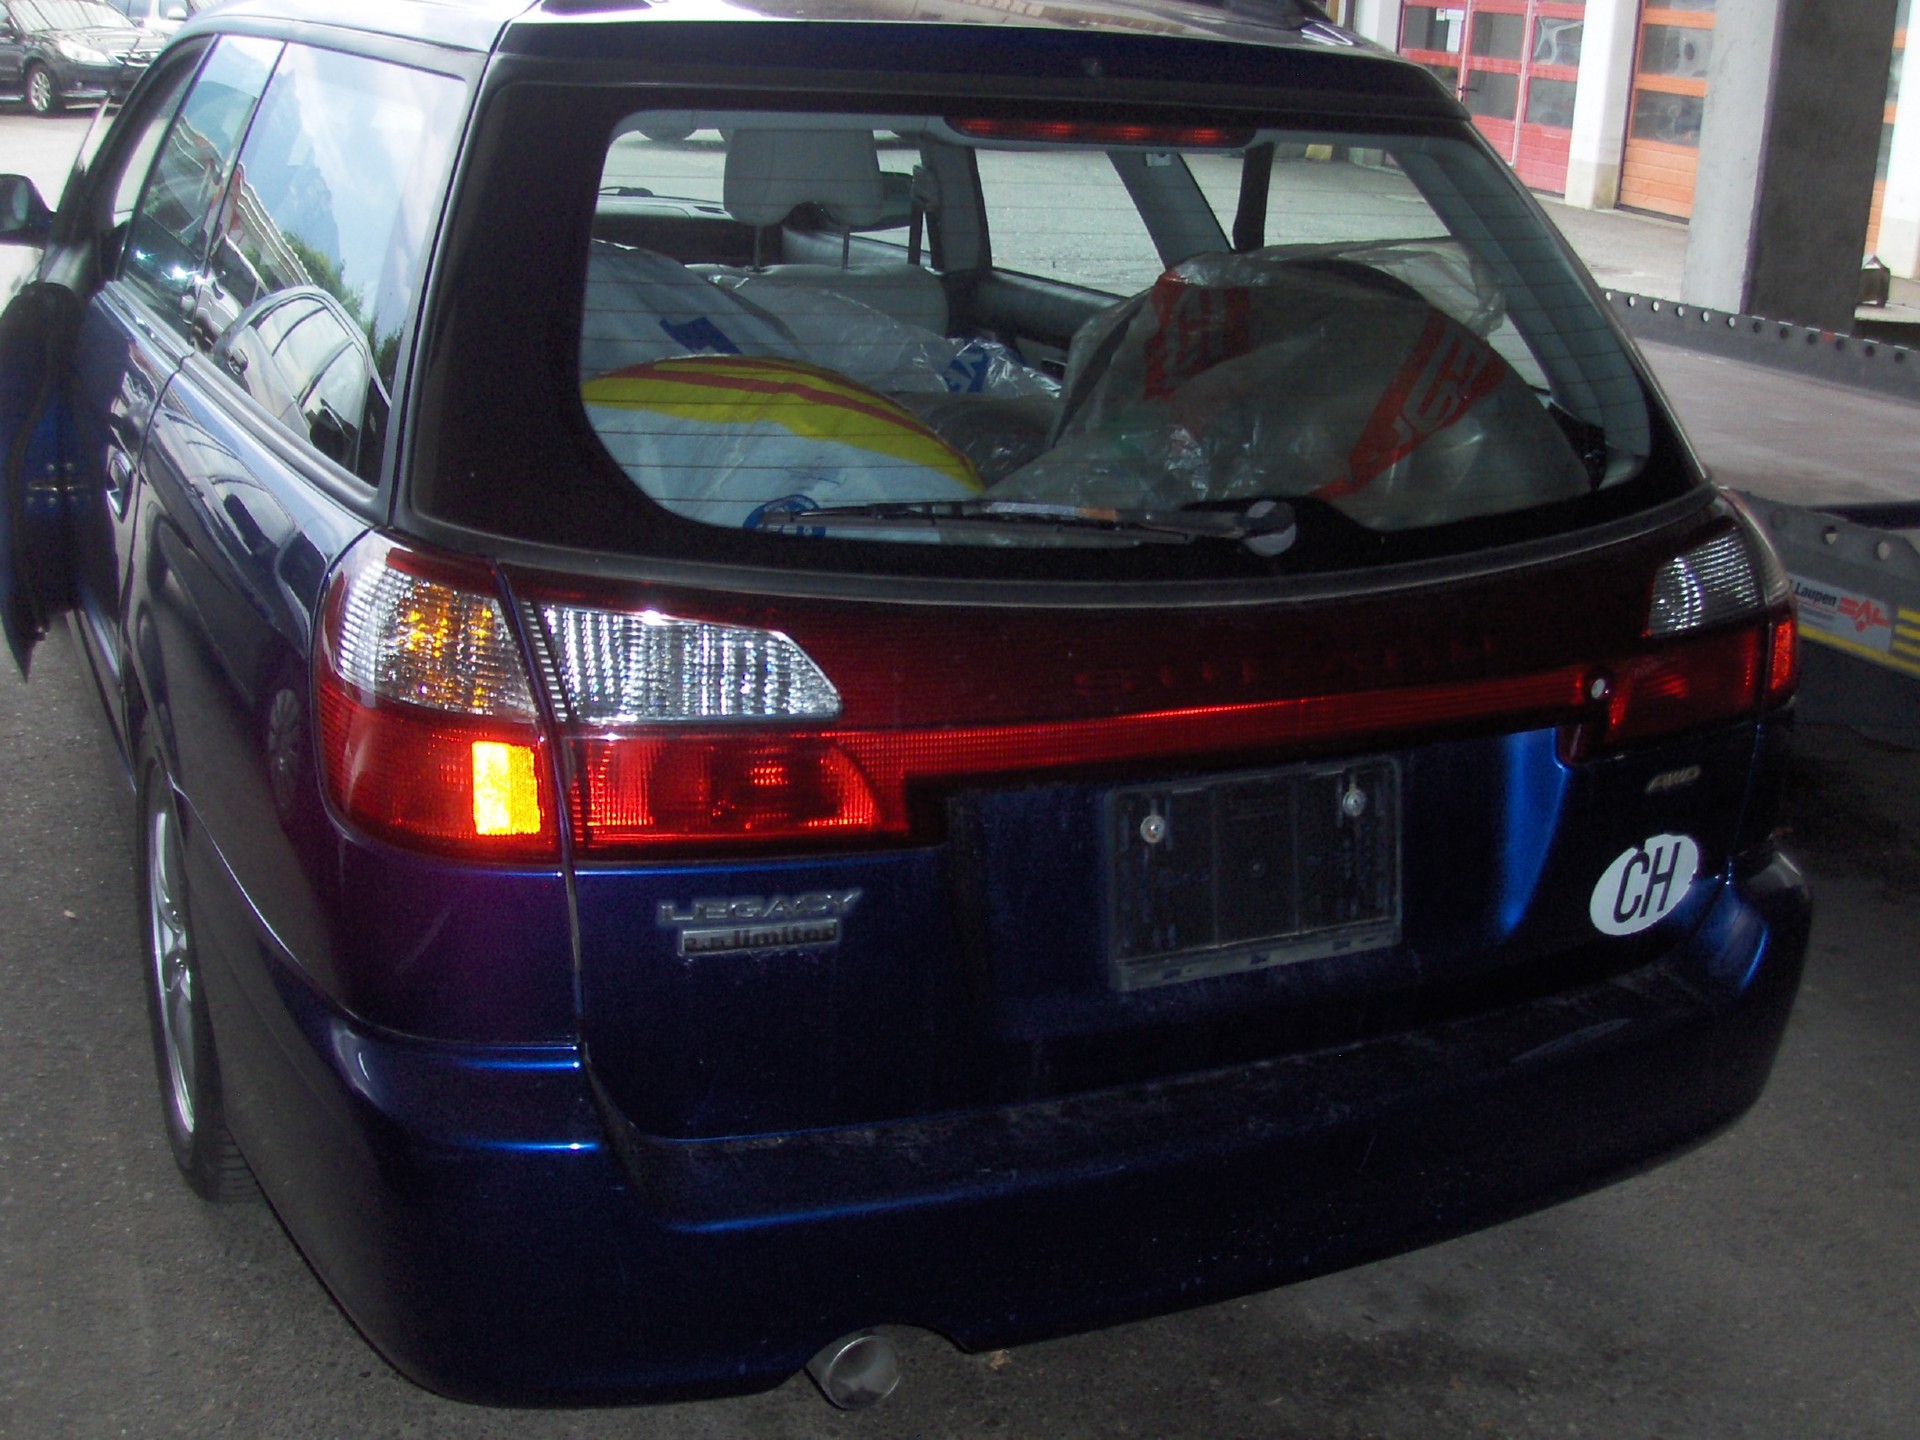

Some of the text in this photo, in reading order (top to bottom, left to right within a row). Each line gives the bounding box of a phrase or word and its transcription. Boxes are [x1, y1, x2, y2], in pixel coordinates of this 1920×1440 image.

[1794, 582, 1838, 607] Laupen
[1613, 841, 1681, 923] CH
[658, 888, 862, 923] LEGACY
